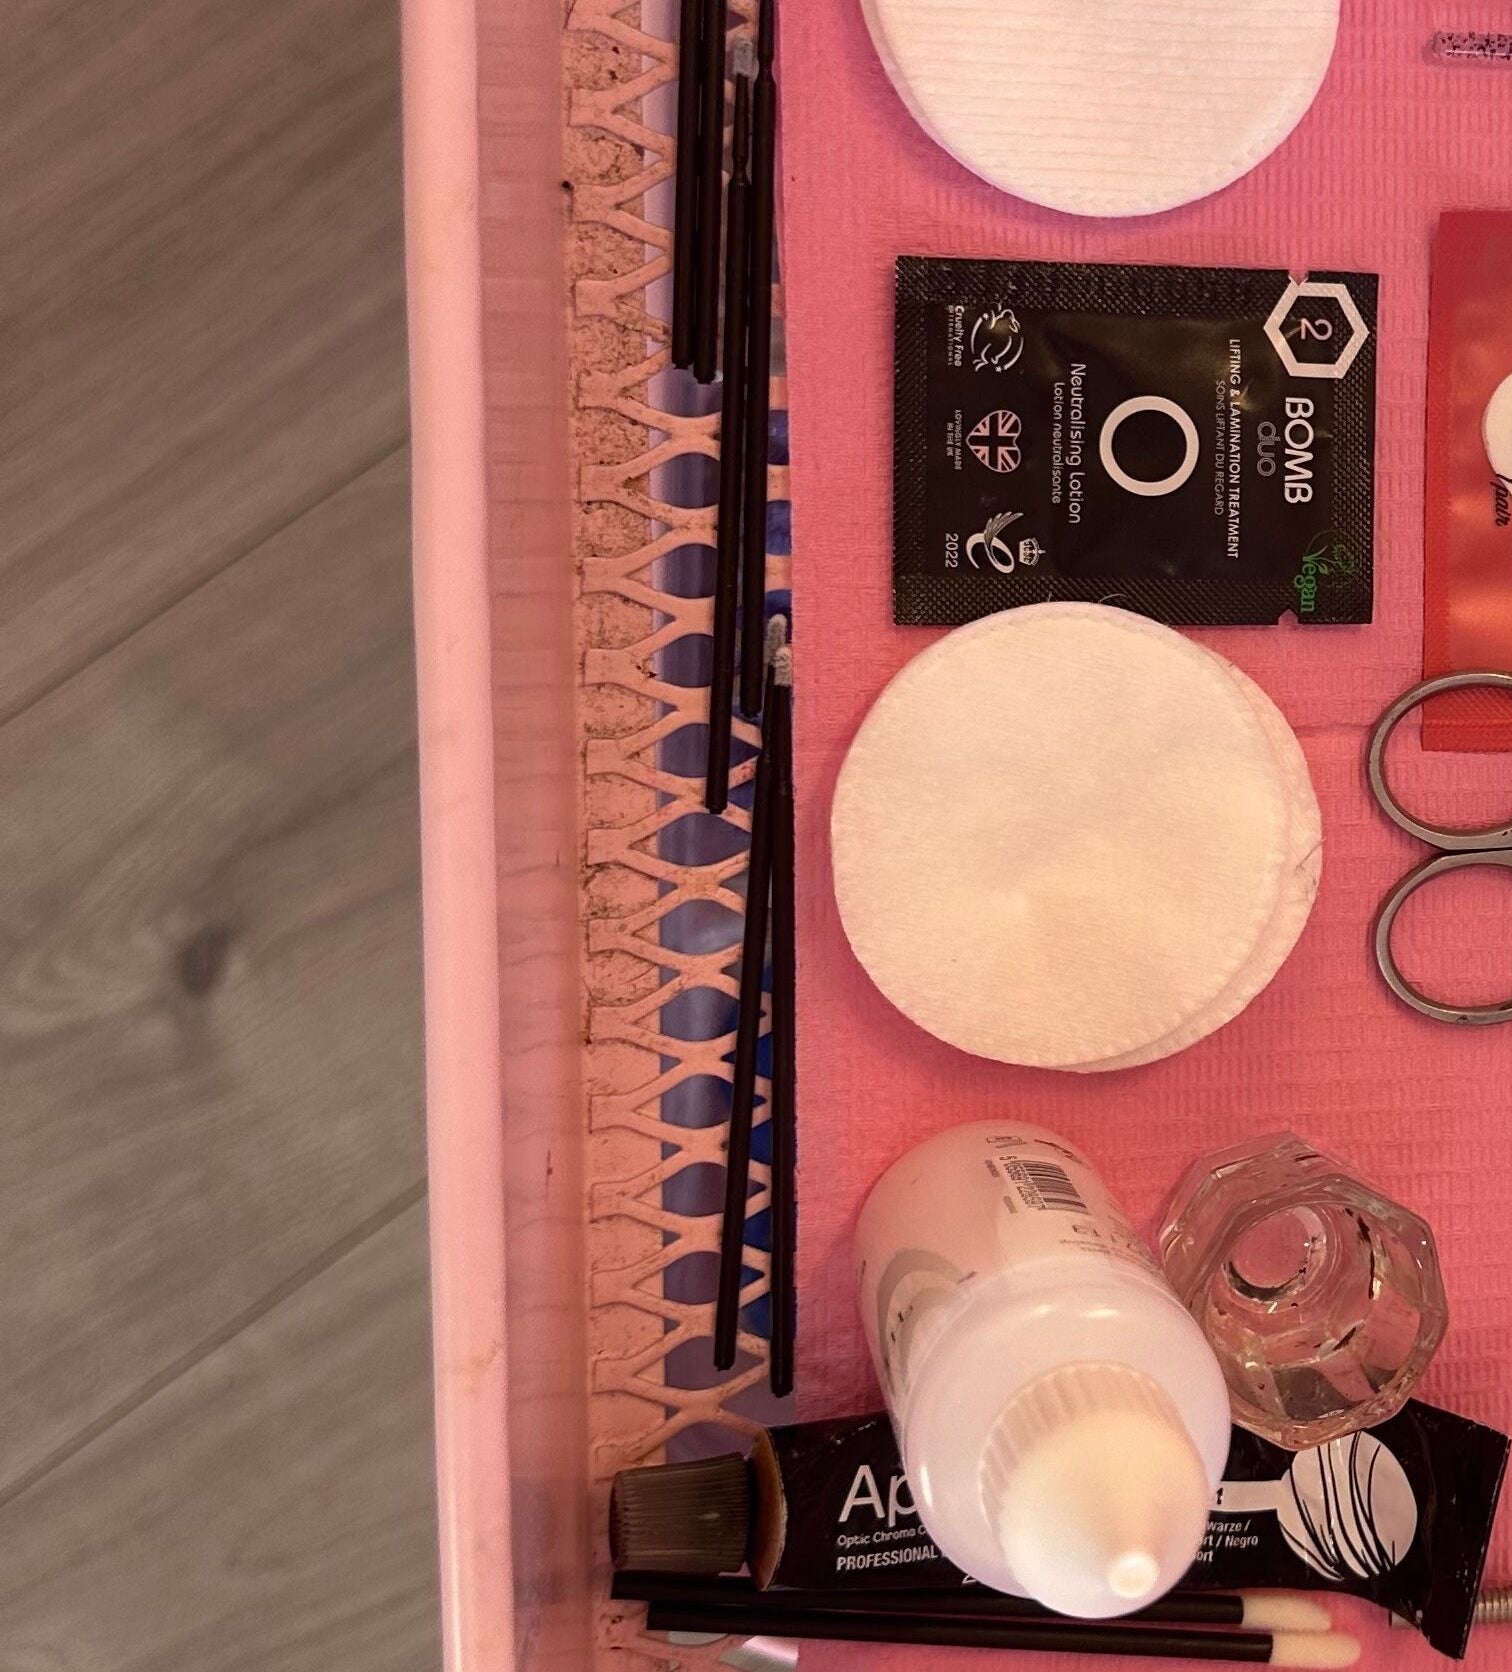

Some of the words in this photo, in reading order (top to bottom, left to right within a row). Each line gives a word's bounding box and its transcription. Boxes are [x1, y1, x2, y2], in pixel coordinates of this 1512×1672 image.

[953, 305, 965, 347] Cruelty
[1300, 317, 1334, 341] 2
[953, 348, 965, 368] Free
[1228, 338, 1242, 386] LIFTING
[1053, 381, 1065, 421] Lotion
[1215, 379, 1226, 412] SOINS
[1229, 387, 1242, 398] &
[1065, 362, 1087, 467] Neutralising
[1215, 413, 1226, 451] LIFTANT
[1051, 423, 1065, 504] neutralisante
[1214, 453, 1226, 470] DU
[1228, 401, 1242, 484] LAMINATION
[1256, 421, 1281, 478] duo
[1284, 396, 1315, 504] BOMB
[1068, 472, 1087, 525] Lotion
[1213, 472, 1225, 516] REGARD
[1489, 481, 1512, 528] pair
[1226, 487, 1241, 560] TREATMENT
[944, 532, 960, 569] 2022
[1294, 546, 1328, 613] Vegan
[836, 1533, 871, 1549] Optic
[872, 1527, 917, 1544] Chroma
[836, 1544, 939, 1572] PROFESSIONAL
[1224, 1535, 1259, 1549] Negro
